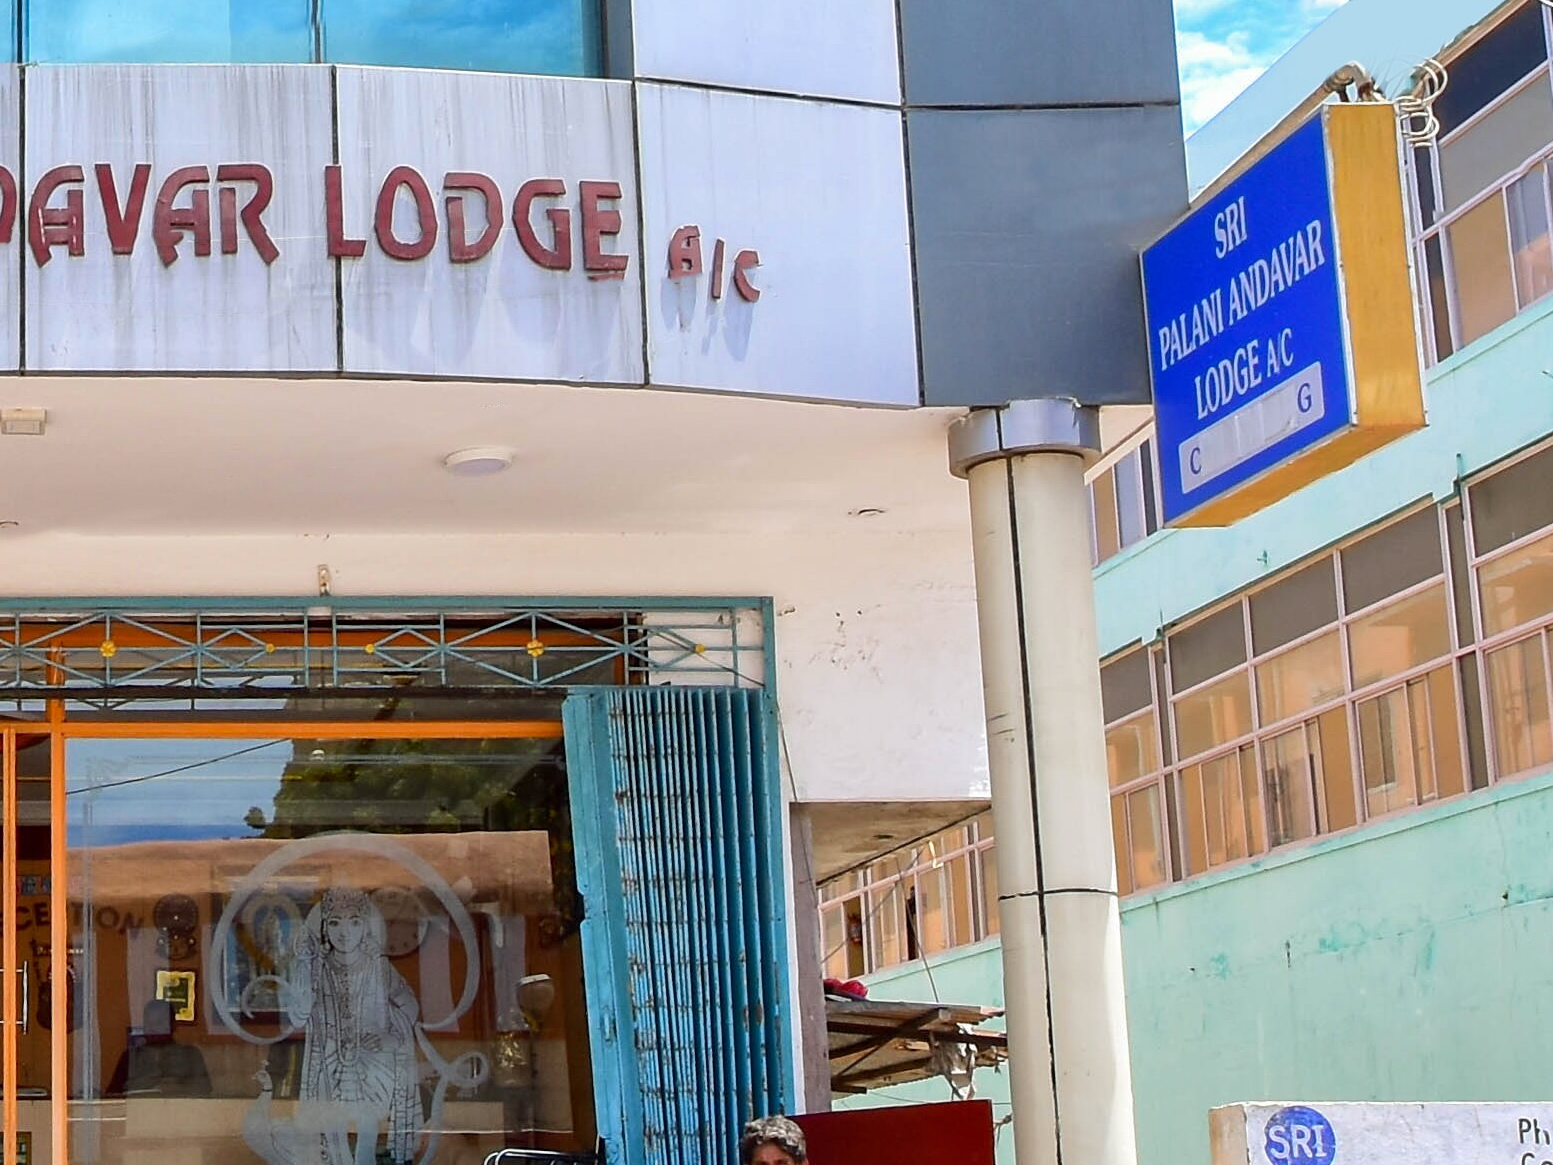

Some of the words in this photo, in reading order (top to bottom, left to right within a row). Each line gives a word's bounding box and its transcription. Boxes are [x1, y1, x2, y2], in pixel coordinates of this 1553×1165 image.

[324, 164, 630, 279] LODGE
[1214, 196, 1248, 259] SRI
[1159, 289, 1224, 371] PALANI
[1229, 219, 1325, 326] ANDAVAR
[1195, 338, 1261, 420] LODGE
[1266, 327, 1294, 378] A/C
[1268, 1123, 1329, 1161] SRI
